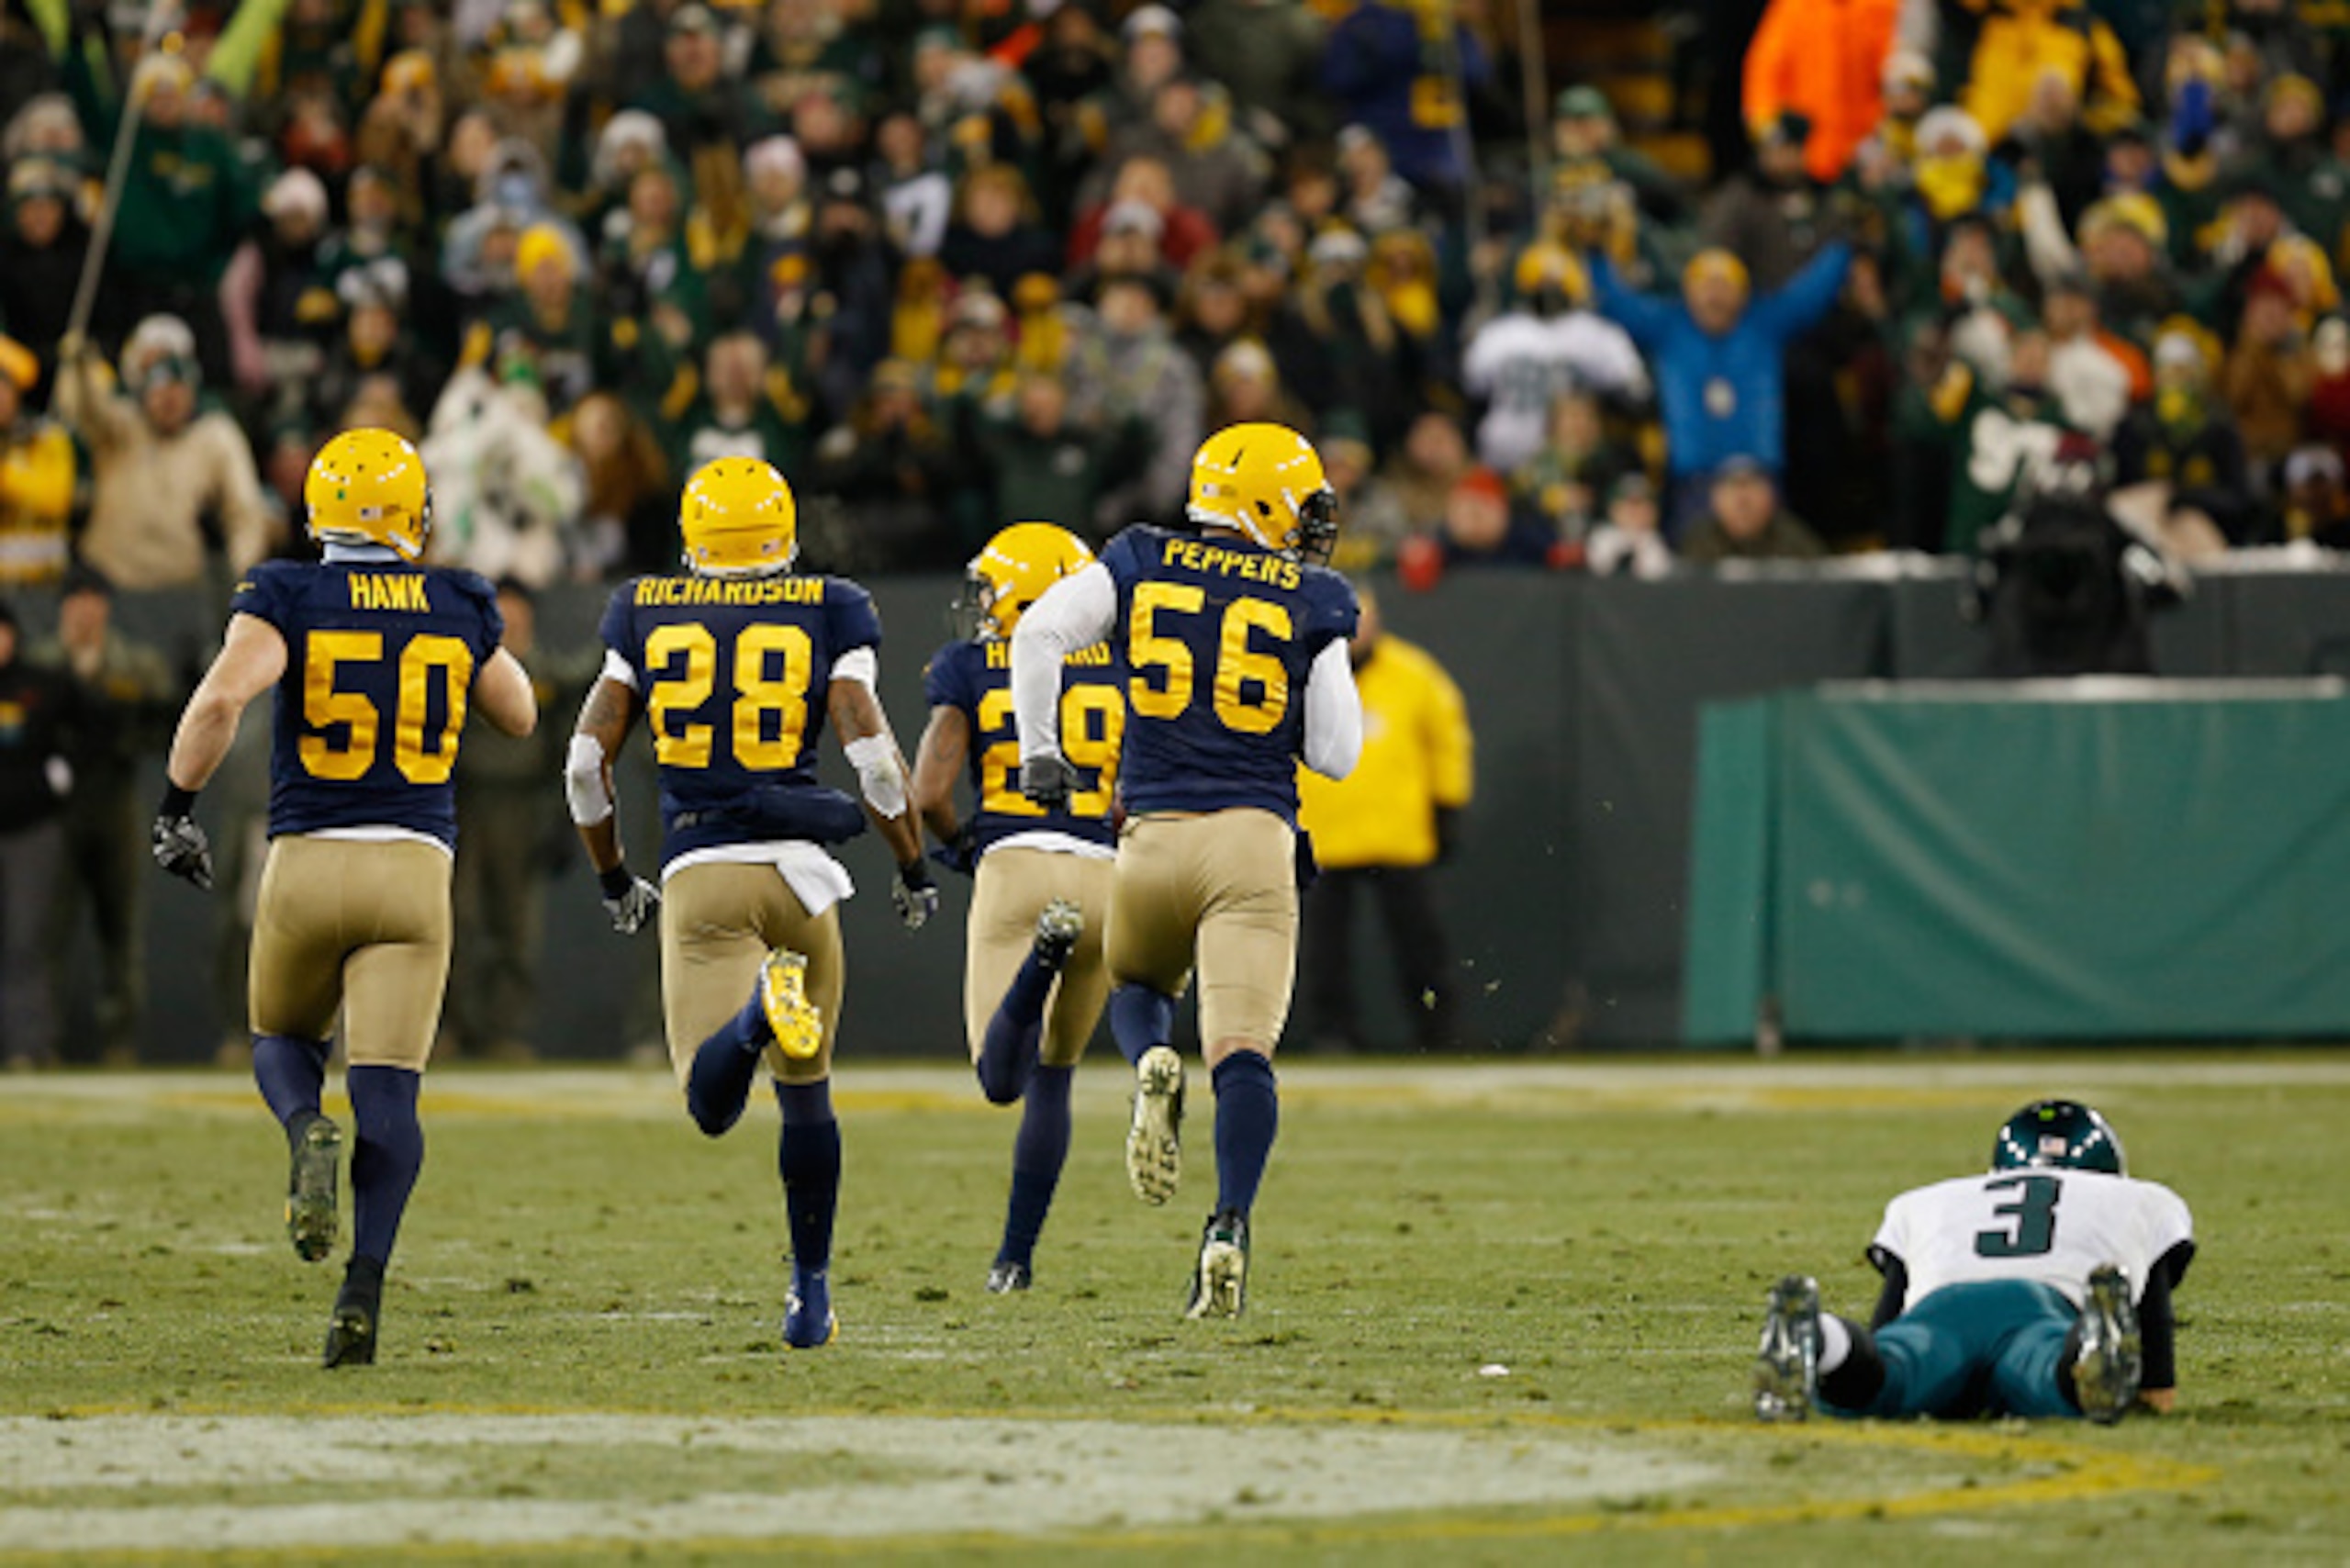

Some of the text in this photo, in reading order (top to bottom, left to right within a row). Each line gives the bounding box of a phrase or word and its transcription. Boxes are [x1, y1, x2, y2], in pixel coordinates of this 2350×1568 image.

[348, 571, 431, 612] HAWK
[633, 577, 825, 606] RICHARDSON
[1163, 539, 1302, 589] PEPPERS
[298, 629, 474, 784] 50
[644, 622, 813, 770] 28
[1129, 581, 1292, 734] 56
[977, 682, 1126, 817] 29
[1975, 1175, 2063, 1257] 3
